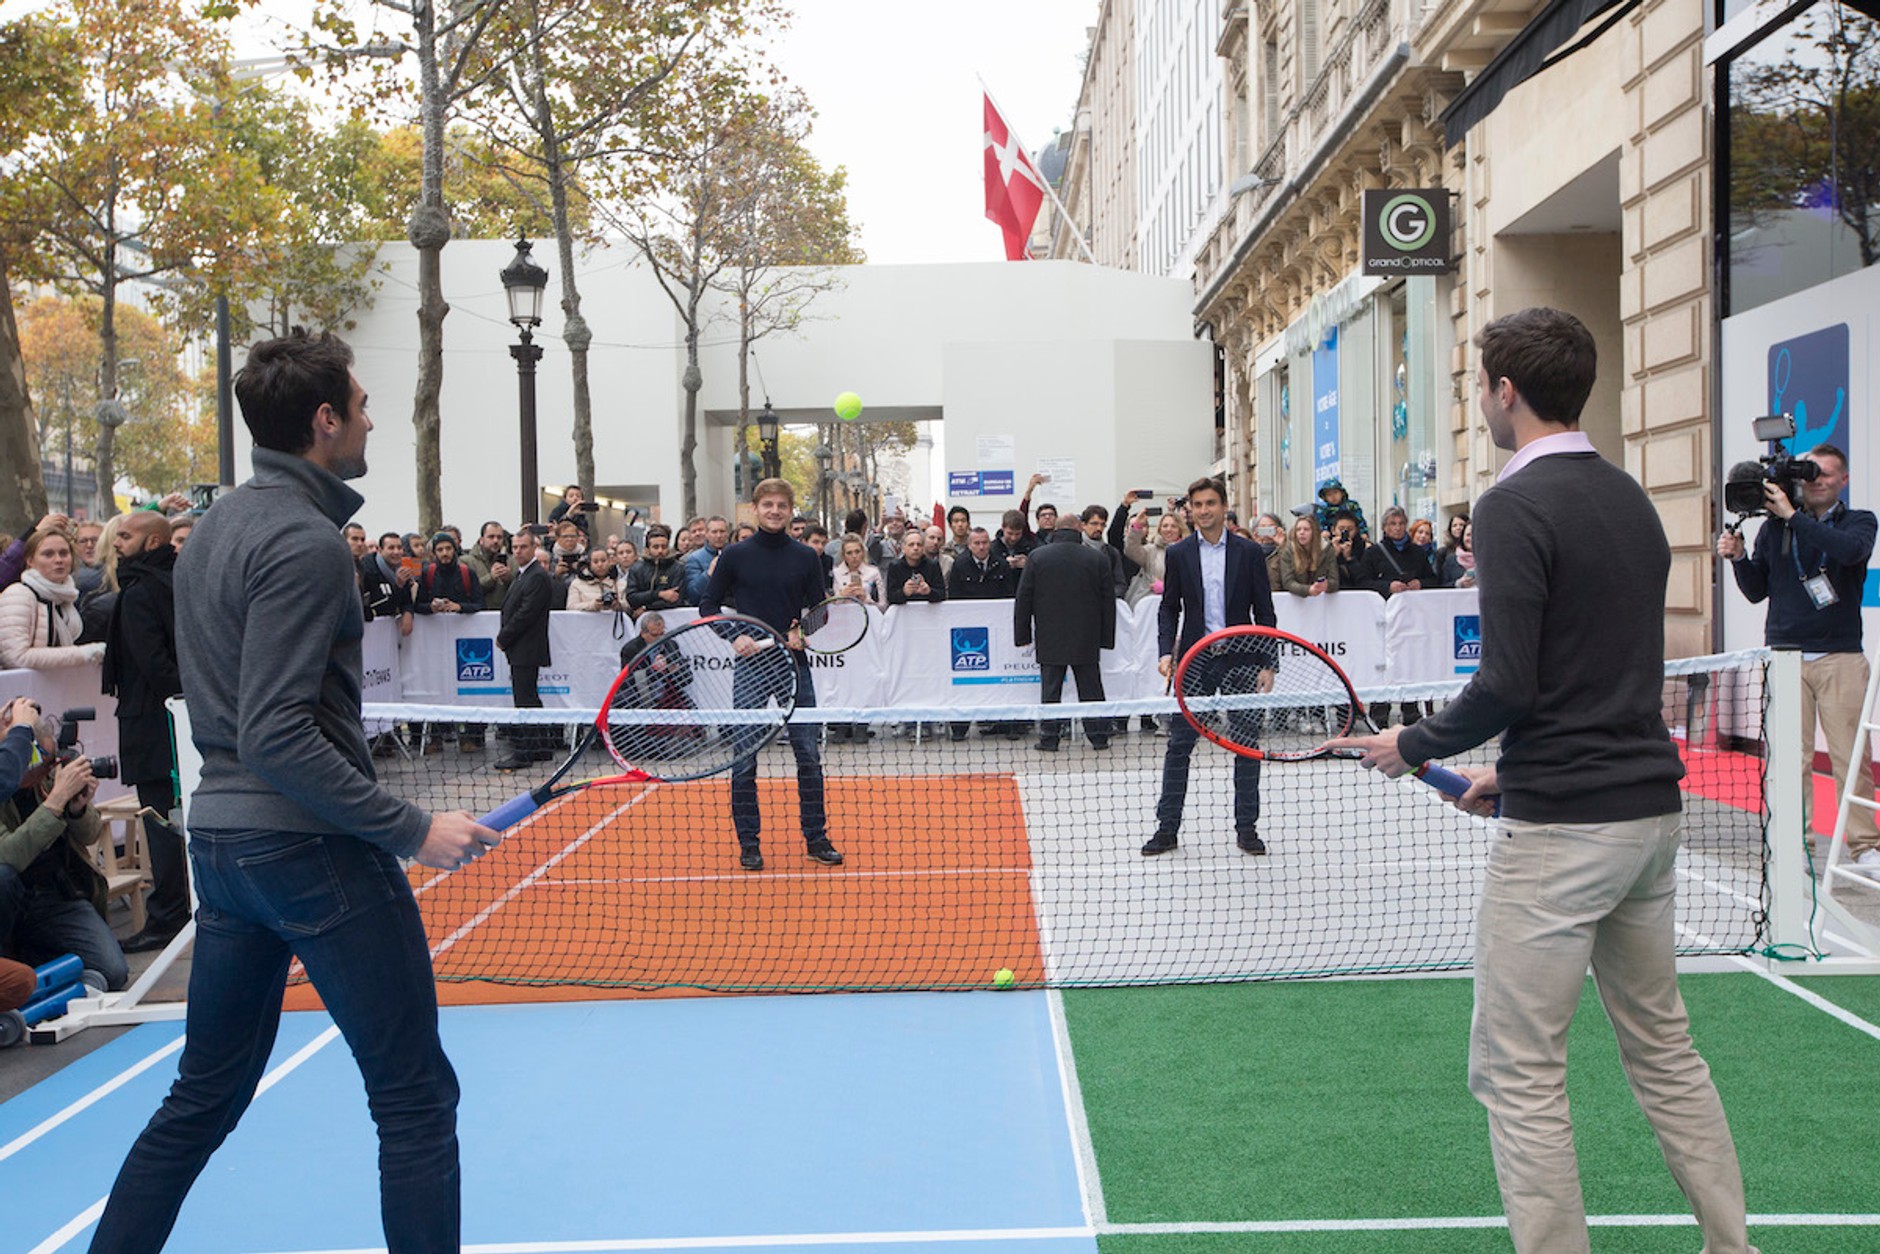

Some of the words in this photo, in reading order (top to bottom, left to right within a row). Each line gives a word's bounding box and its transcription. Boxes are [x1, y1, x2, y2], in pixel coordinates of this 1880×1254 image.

[1389, 203, 1426, 242] G
[951, 489, 980, 497] RETRAIT
[955, 655, 987, 666] ATP
[460, 666, 491, 677] ATP
